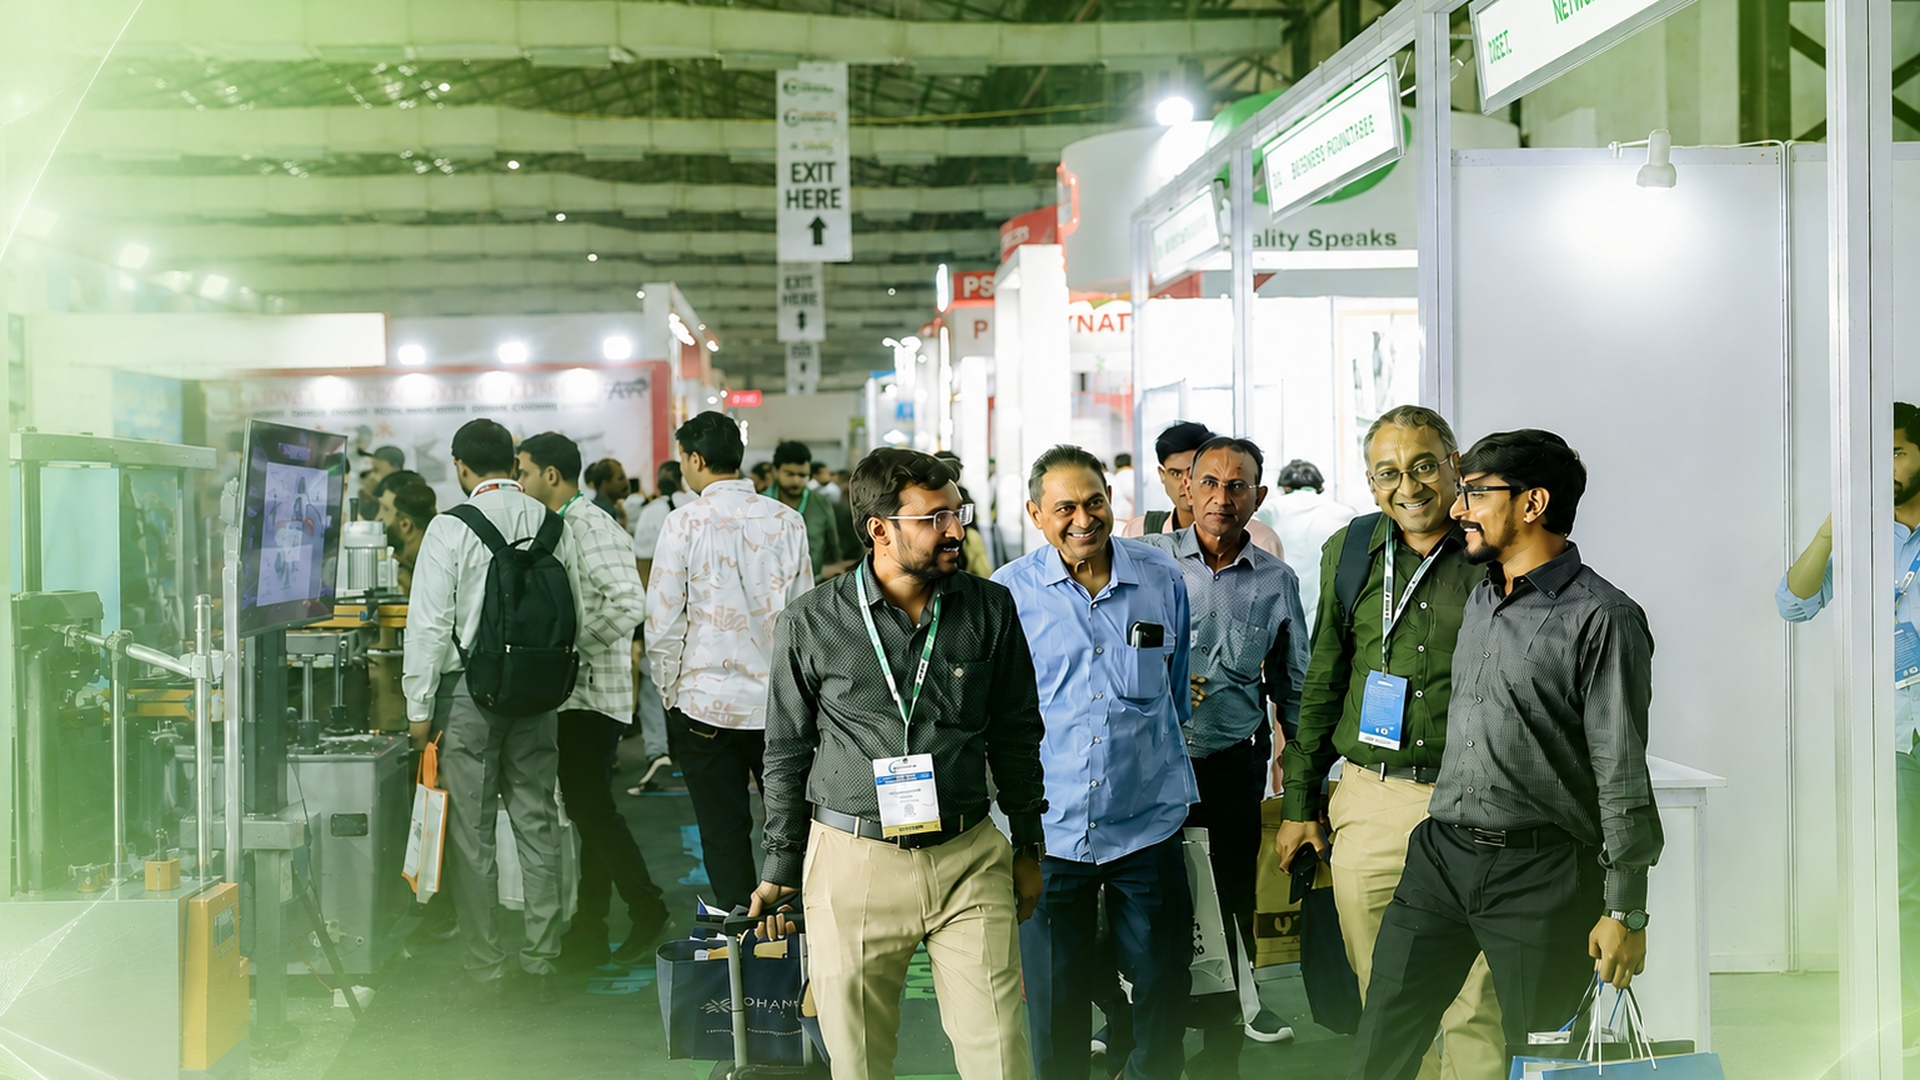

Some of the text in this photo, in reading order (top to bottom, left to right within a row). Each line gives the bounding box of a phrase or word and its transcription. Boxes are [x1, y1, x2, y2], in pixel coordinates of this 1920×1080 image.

[791, 161, 836, 183] EXIT
[785, 187, 841, 210] HERE
[1252, 228, 1397, 251] ality Speaks
[963, 275, 995, 298] PS
[1069, 313, 1132, 333] NAT
